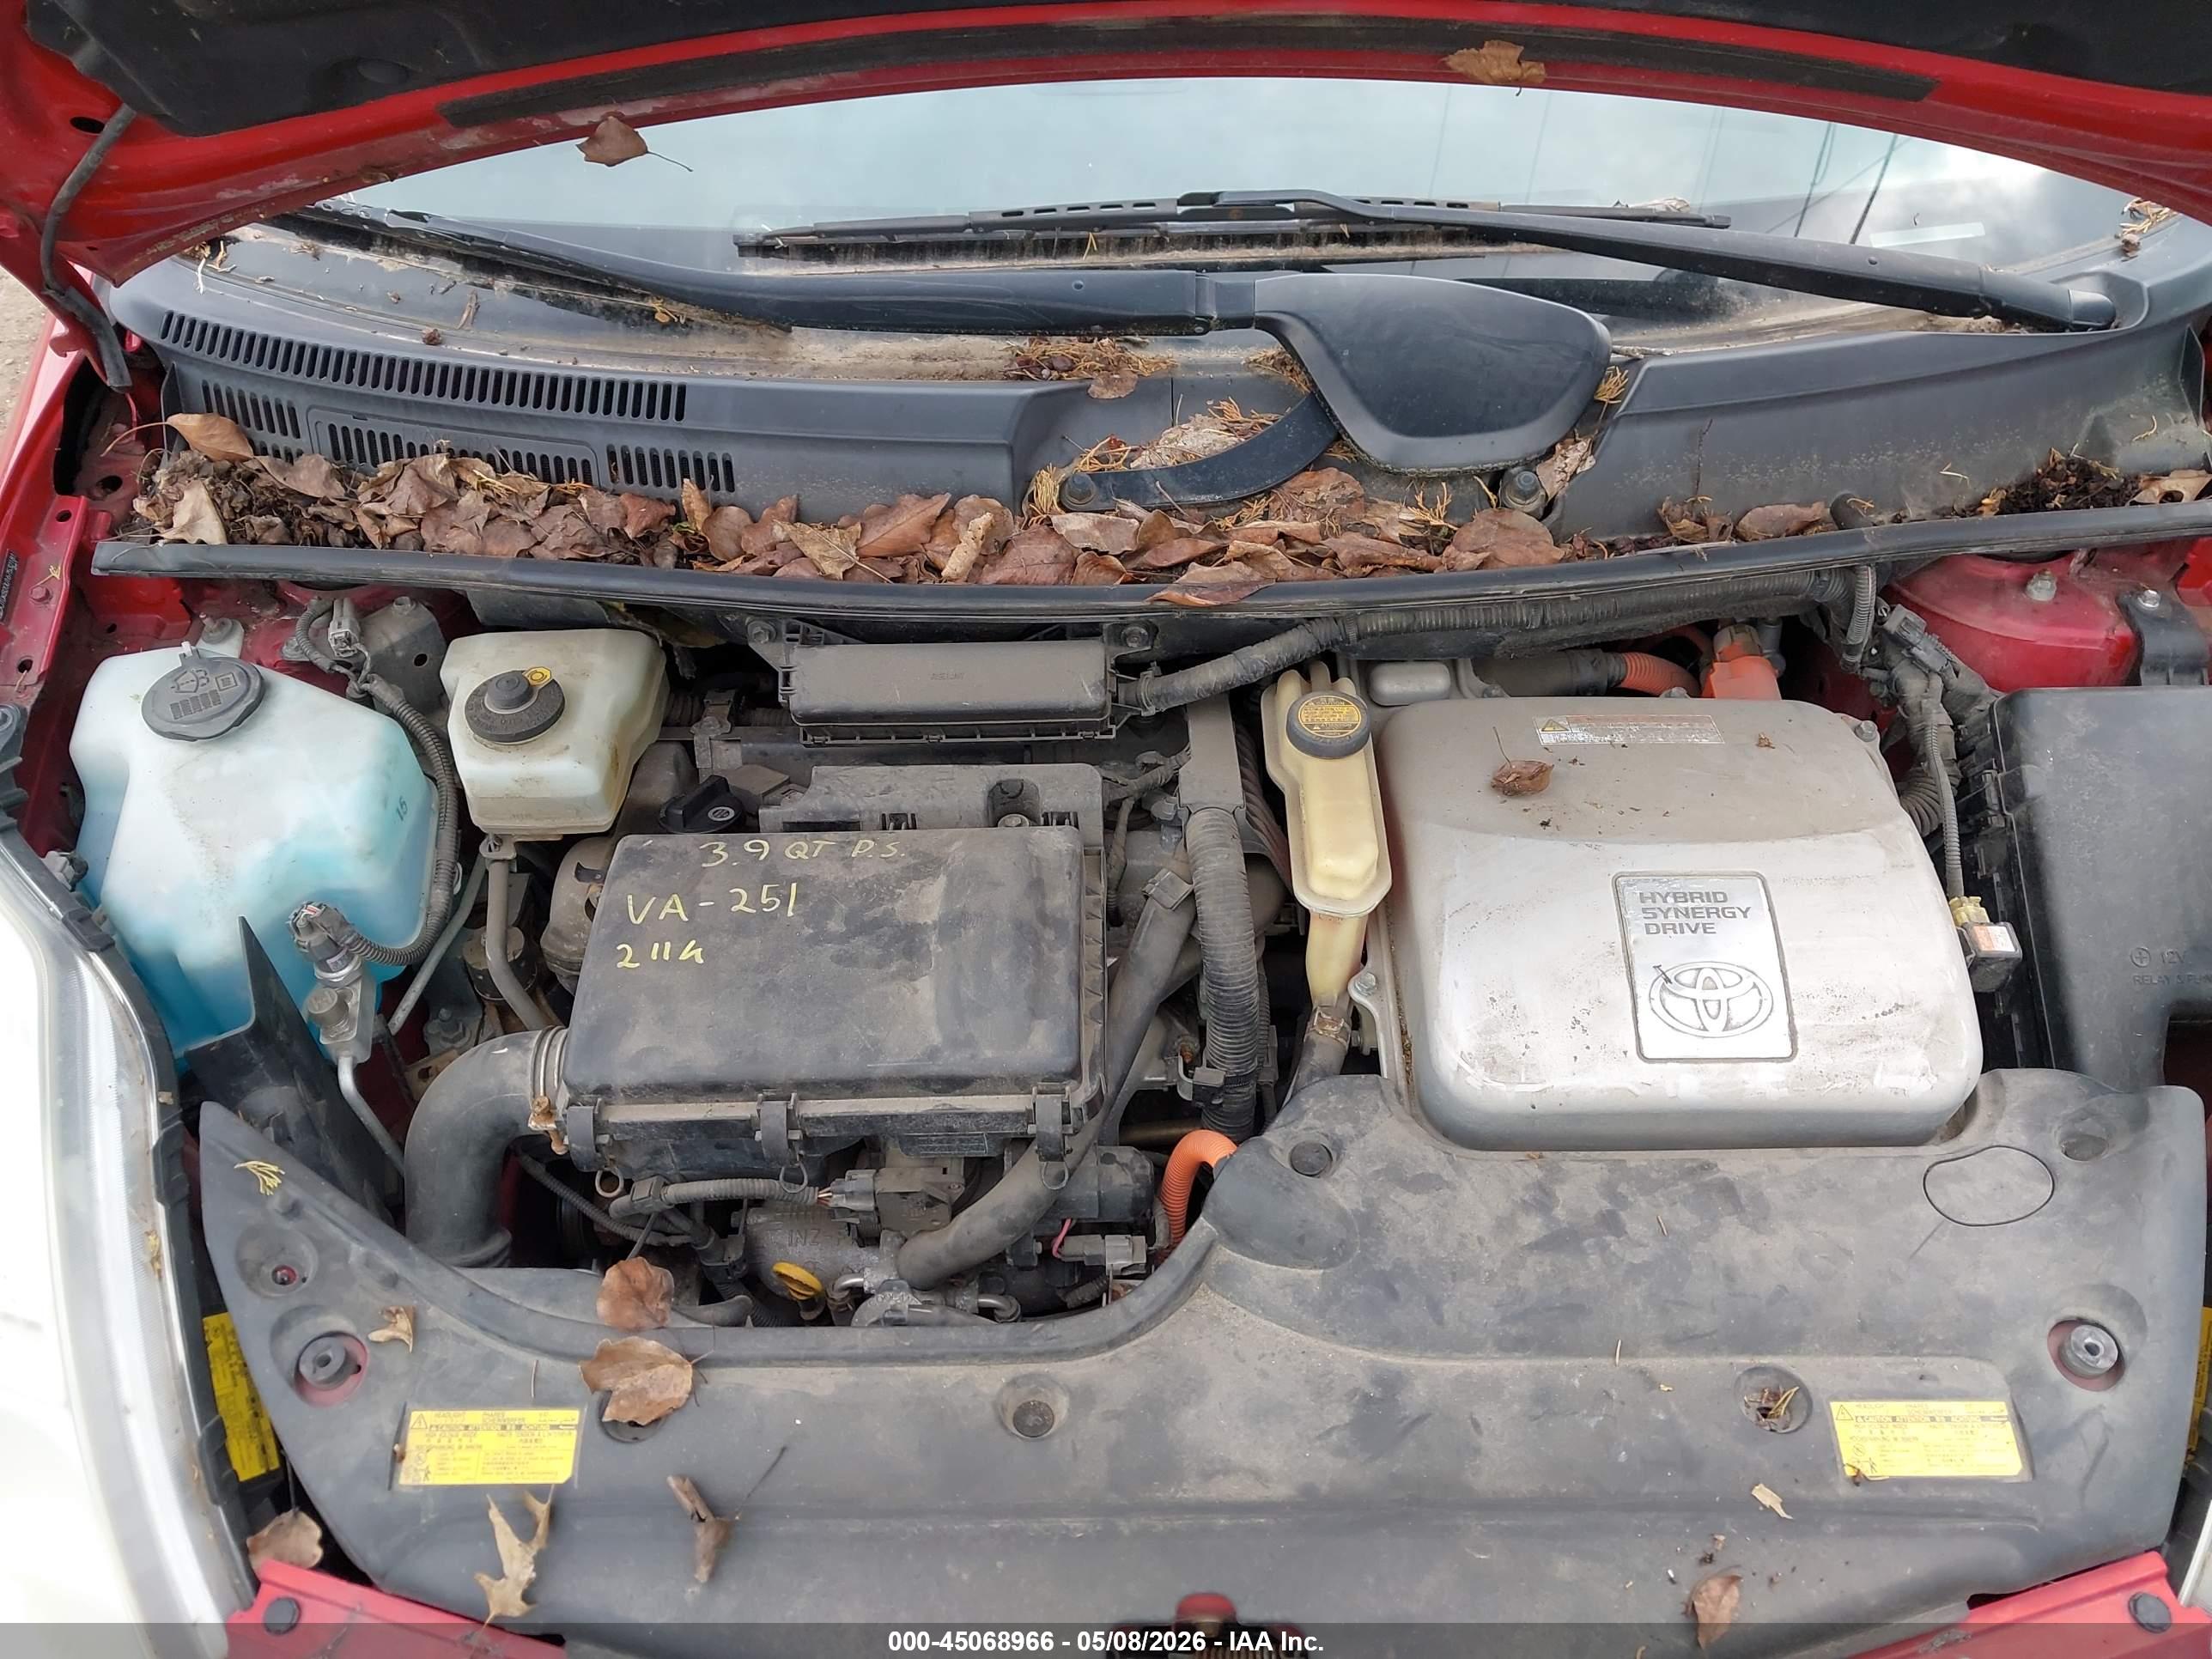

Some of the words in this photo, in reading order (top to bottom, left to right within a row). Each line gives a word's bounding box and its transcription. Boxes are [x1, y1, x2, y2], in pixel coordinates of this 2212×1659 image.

[699, 839, 770, 867] 3.9
[784, 840, 836, 860] QT
[1639, 891, 1728, 903] HYBRID
[1641, 907, 1752, 919] SYNERGY
[1644, 922, 1717, 934] DRIVE
